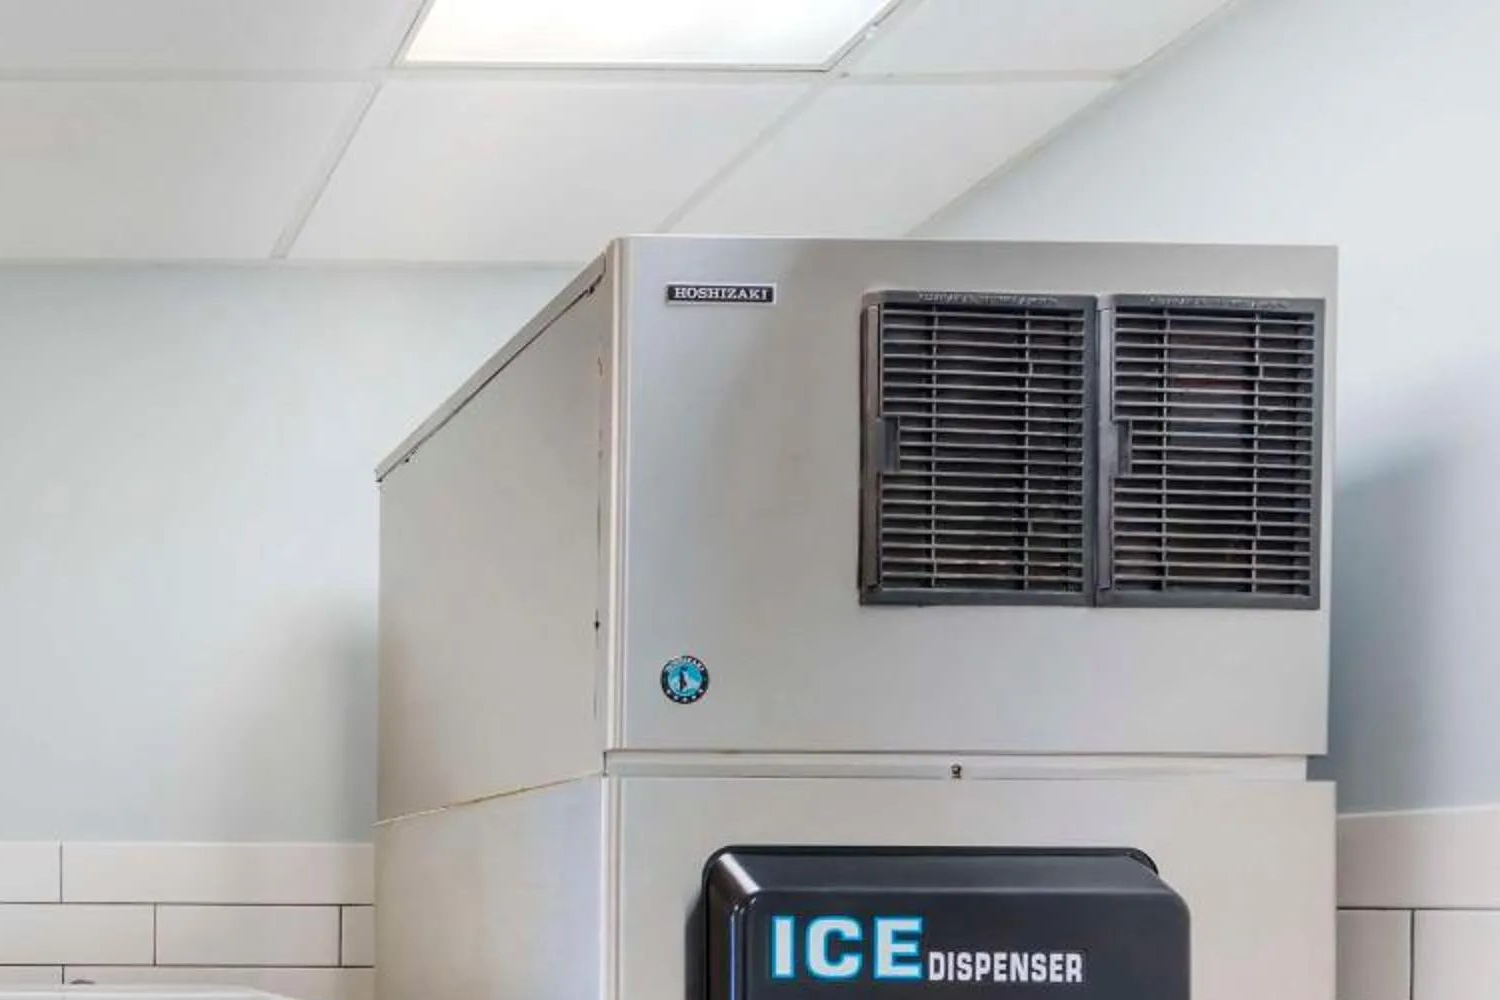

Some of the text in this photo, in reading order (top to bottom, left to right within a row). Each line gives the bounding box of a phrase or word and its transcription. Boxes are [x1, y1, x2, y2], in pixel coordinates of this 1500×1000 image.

[673, 286, 769, 301] HOSHIZAKI
[770, 914, 1084, 984] ICE DISPENSER
